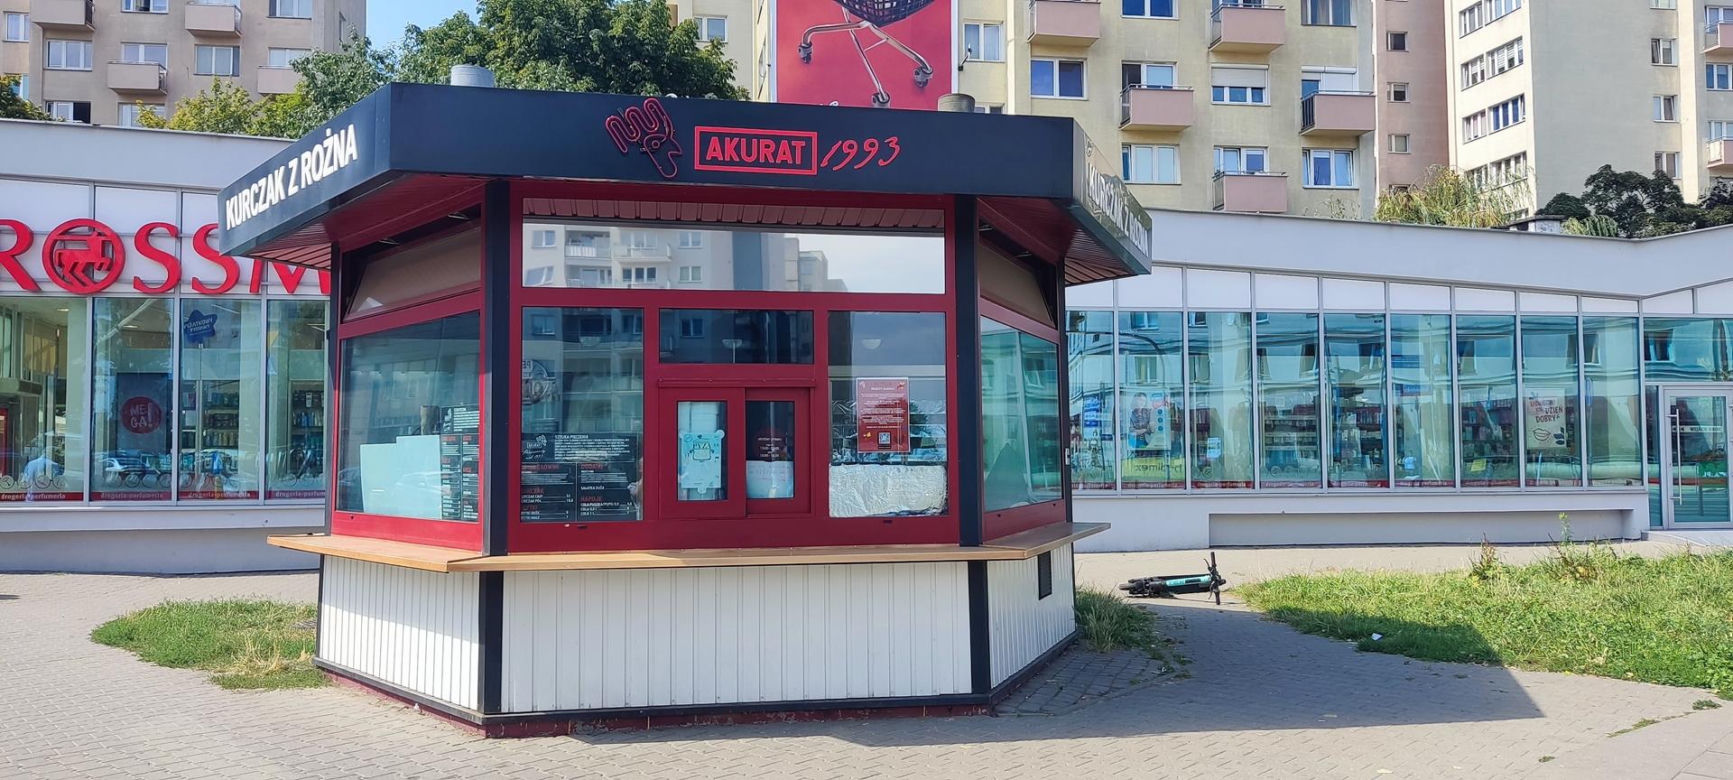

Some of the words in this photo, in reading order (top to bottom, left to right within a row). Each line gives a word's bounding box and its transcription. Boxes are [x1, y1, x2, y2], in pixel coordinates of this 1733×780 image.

[226, 165, 287, 231] KURCZAK
[287, 157, 299, 197] Z
[300, 123, 358, 190] ROŻNA
[705, 136, 806, 165] AKURAT
[820, 135, 901, 171] 1993
[1088, 162, 1124, 232] KURCZAK
